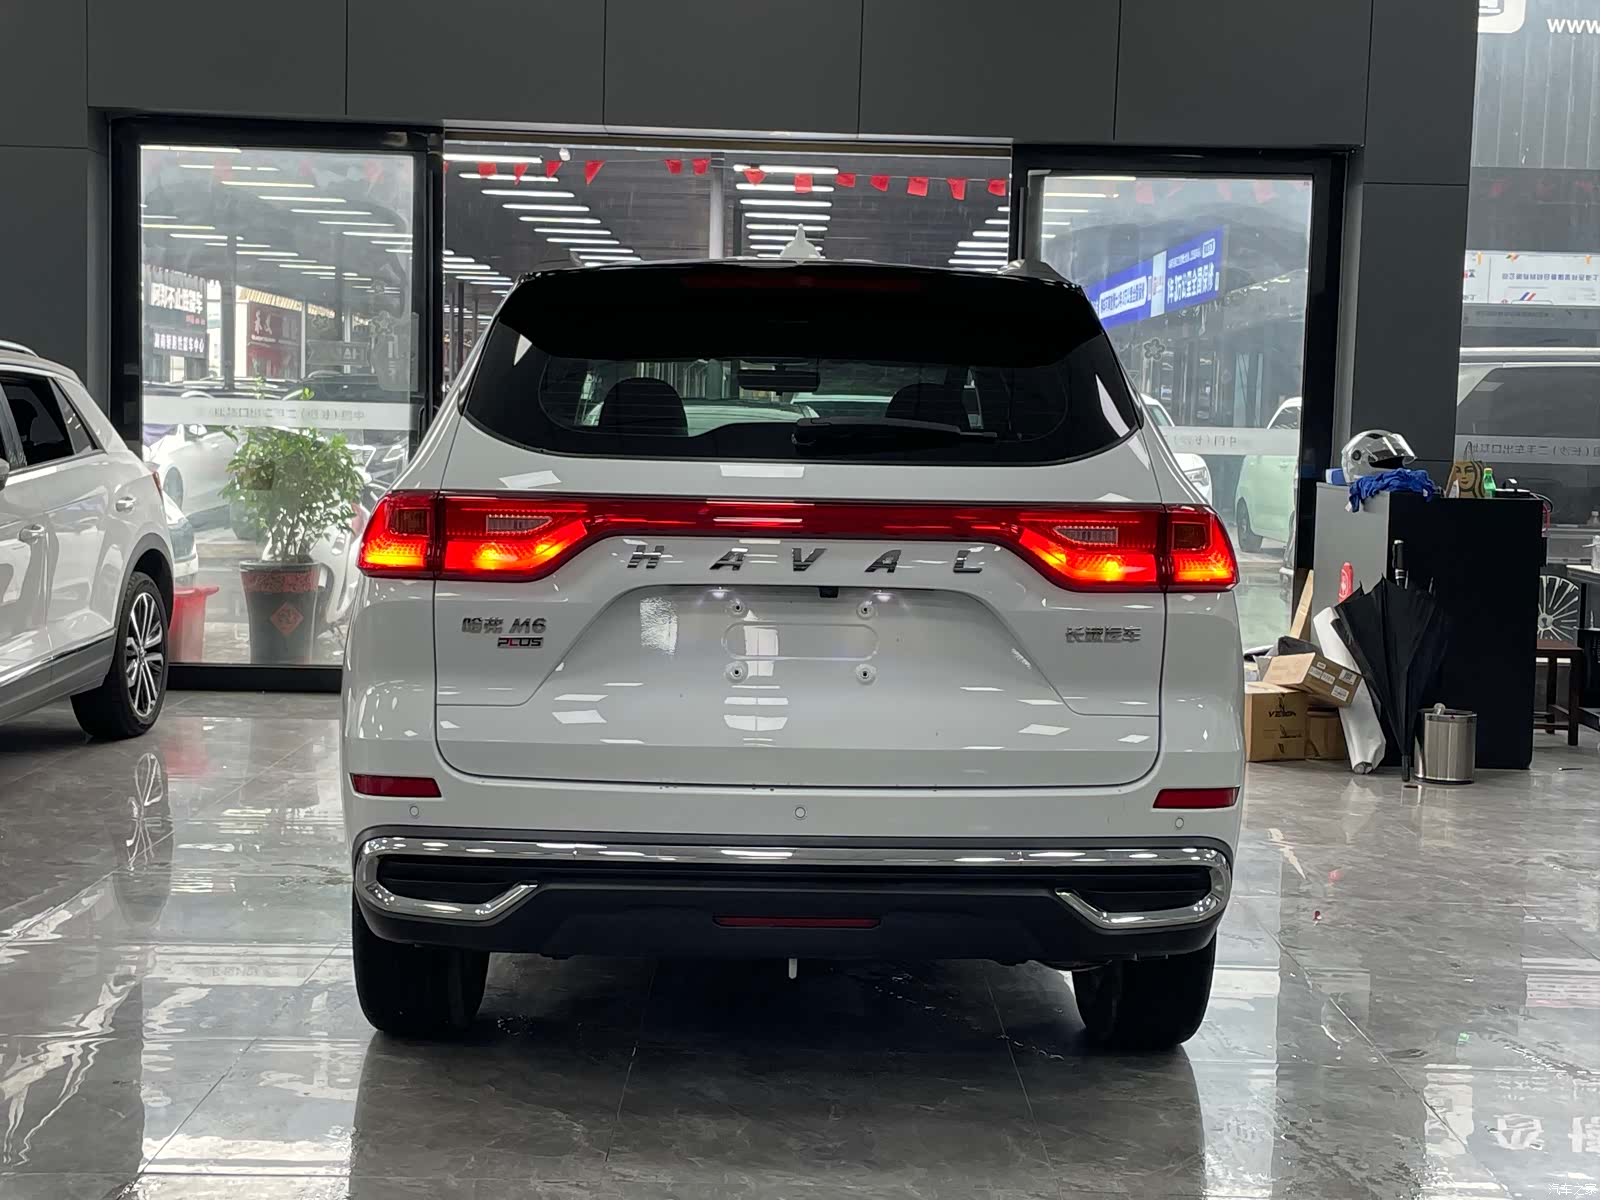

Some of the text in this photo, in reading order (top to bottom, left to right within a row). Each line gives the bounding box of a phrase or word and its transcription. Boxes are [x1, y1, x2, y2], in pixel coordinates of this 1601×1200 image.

[627, 544, 984, 574] HAVAL
[462, 616, 547, 634] 哈弗 M6
[1065, 625, 1142, 643] 长城汽车
[497, 636, 544, 648] PLUS
